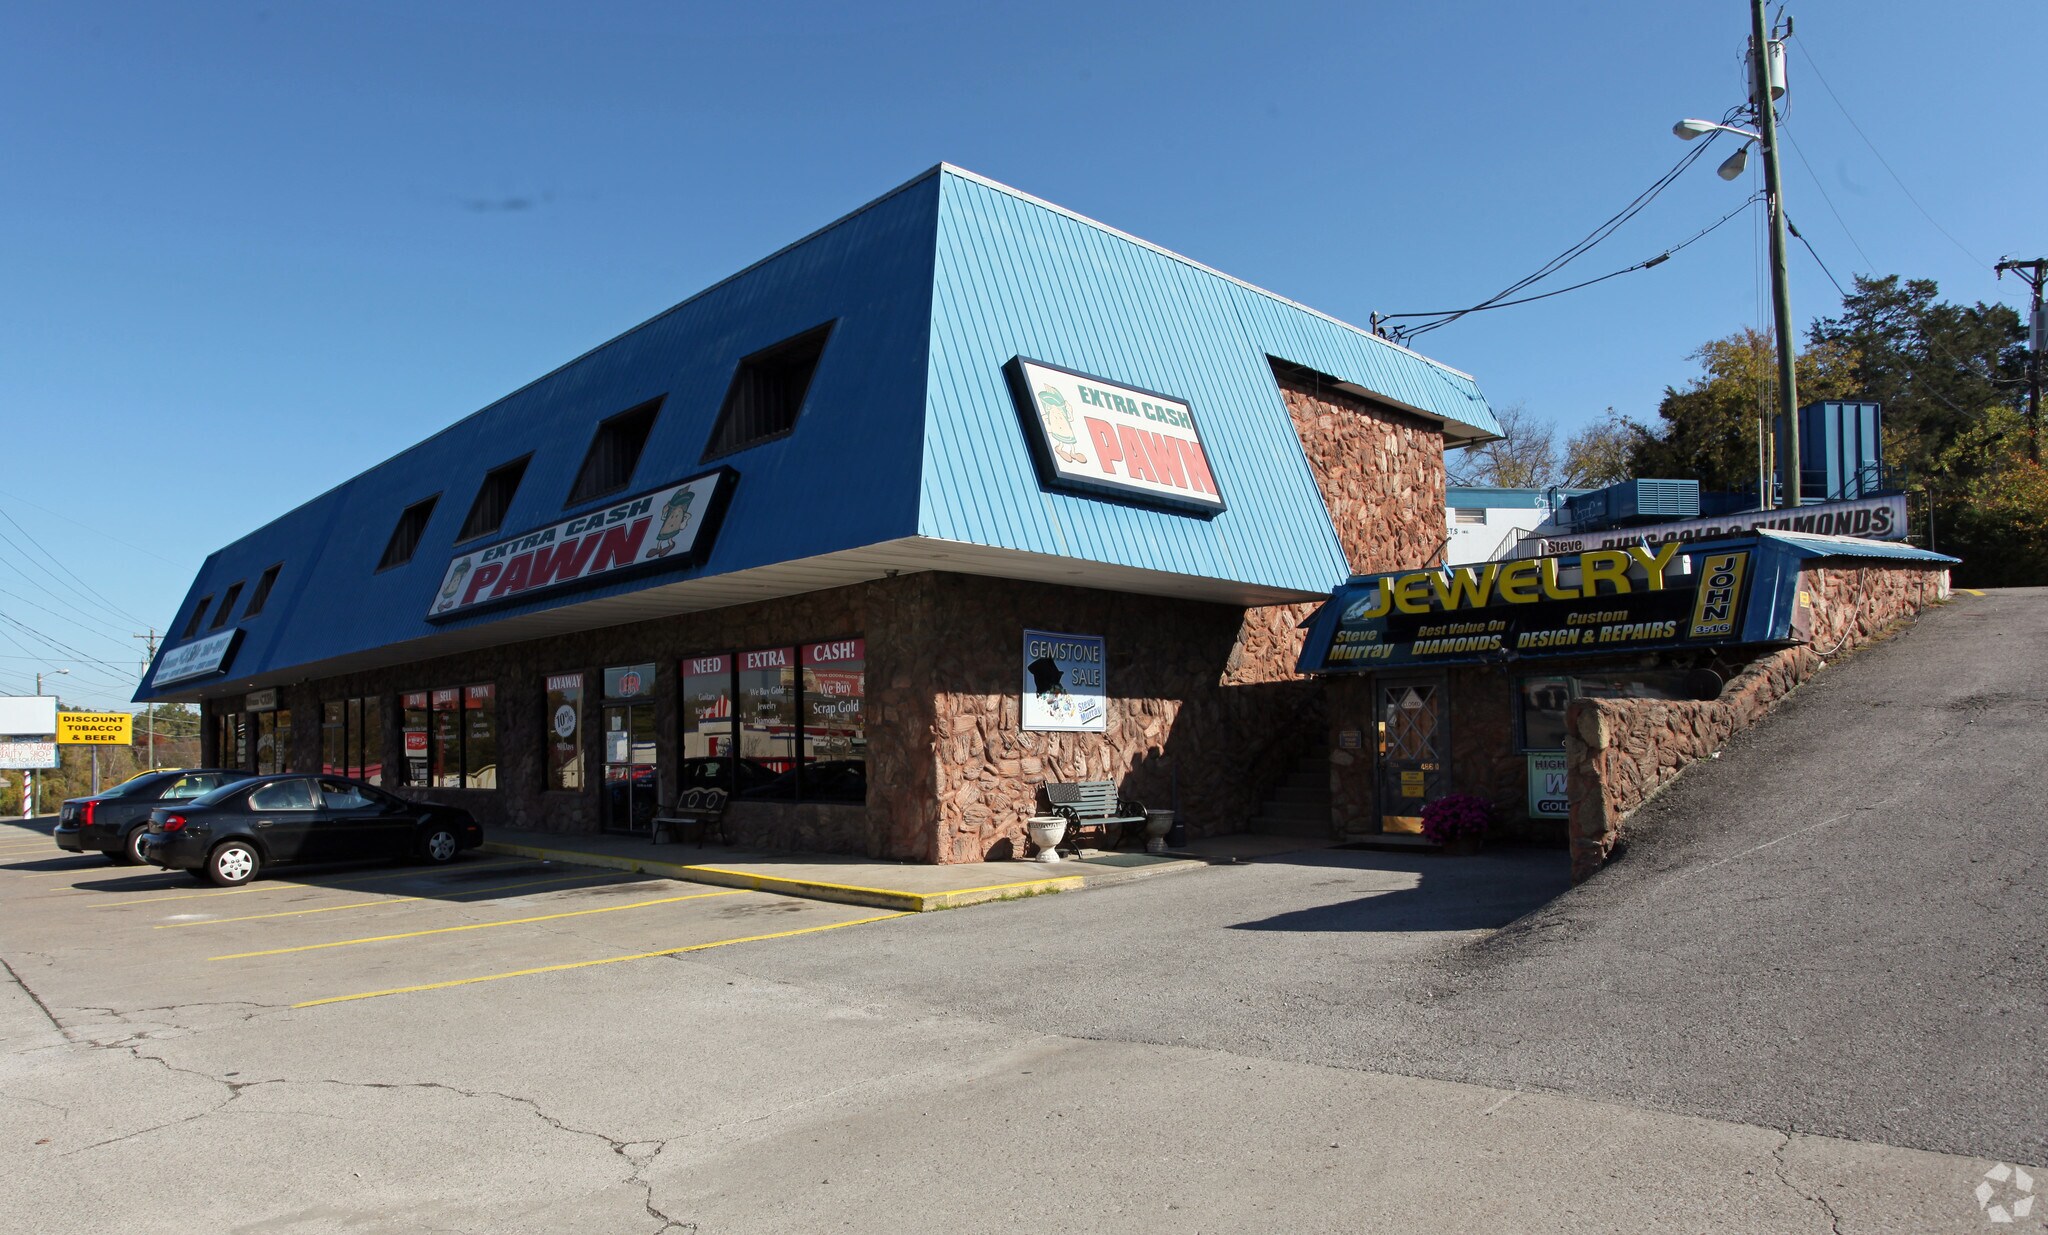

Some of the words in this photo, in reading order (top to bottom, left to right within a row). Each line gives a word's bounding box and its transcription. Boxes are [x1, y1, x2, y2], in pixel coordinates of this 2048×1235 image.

[1077, 384, 1141, 417] EXTRA
[1141, 401, 1192, 430] CASH
[1083, 415, 1219, 496] PAWN
[480, 528, 556, 564] EXTRA
[564, 497, 653, 537] CASH
[1548, 537, 1583, 554] Steve
[458, 514, 654, 608] PAWN
[1363, 541, 1682, 619] JEWELRY
[1702, 555, 1736, 622] JOHN
[1566, 609, 1629, 625] Custom
[1335, 629, 1378, 643] Steve
[1418, 625, 1447, 638] Best
[1448, 622, 1485, 636] Value
[1487, 619, 1506, 632] On
[1517, 628, 1580, 649] DESIGN
[1582, 629, 1595, 644] &
[1599, 620, 1677, 643] REPAIRS
[1695, 623, 1730, 634] 3:16
[1029, 640, 1099, 662] GEMSTONE
[1328, 643, 1395, 661] Murray
[1411, 634, 1502, 656] DIAMONDS
[692, 657, 722, 674] NEED
[747, 649, 786, 669] EXTRA
[813, 641, 856, 662] CASH!
[548, 674, 582, 690] LAYAWAY
[1072, 667, 1100, 686] SALE
[440, 690, 452, 702] SELL
[471, 686, 489, 698] PAWN
[750, 688, 759, 696] We
[771, 685, 784, 695] Gold
[819, 682, 835, 695] We
[835, 681, 852, 698] Buy
[409, 694, 421, 705] BUY
[757, 702, 777, 712] Jewelry
[812, 702, 836, 717] Scrap
[838, 699, 860, 713] Gold
[1077, 697, 1096, 712] Steve
[63, 715, 125, 723] DISCOUNT
[556, 708, 574, 728] 10%
[754, 716, 781, 726] Diamonds
[67, 724, 123, 732] TOBACCO
